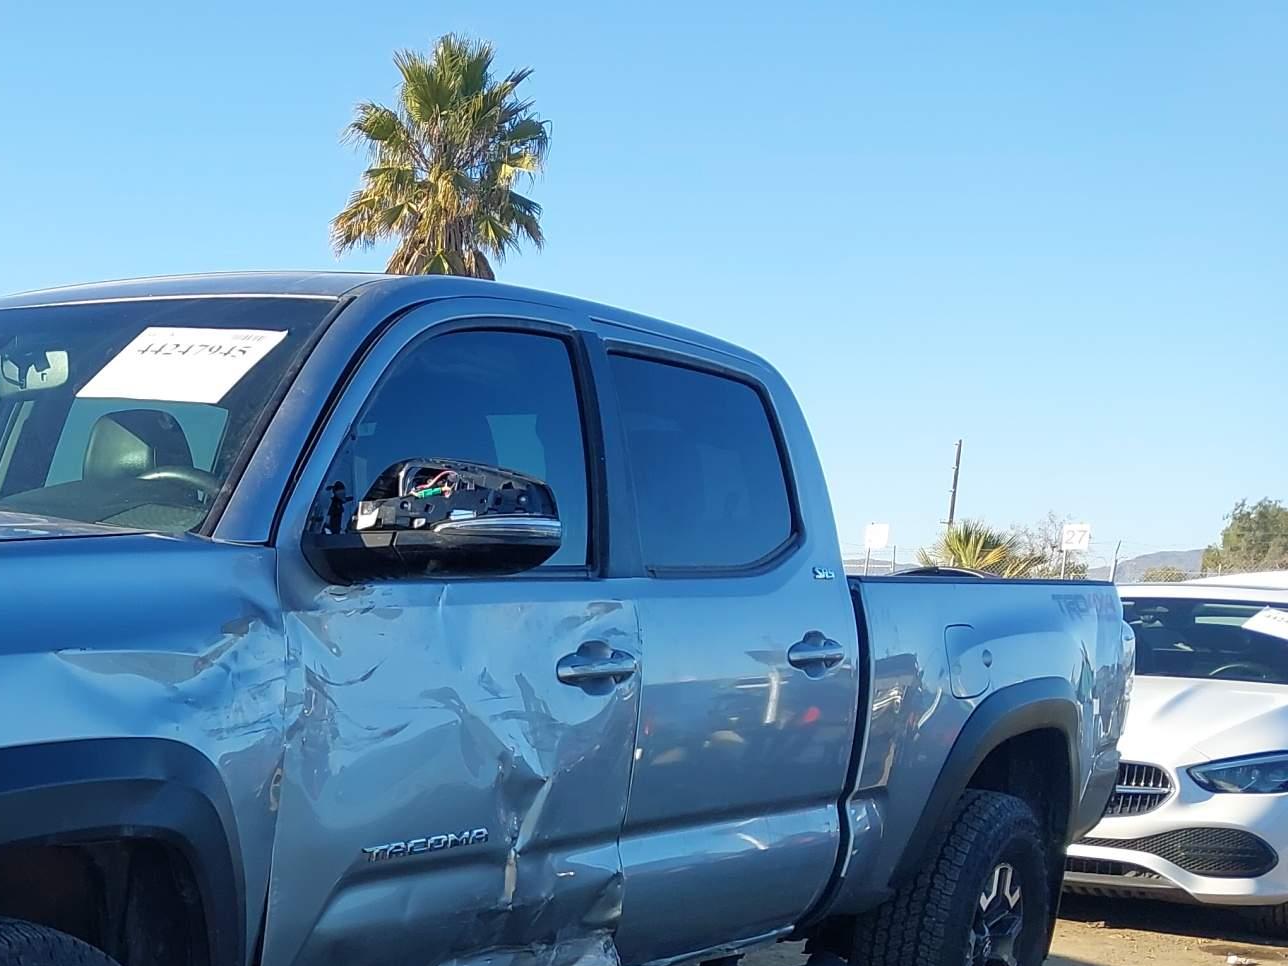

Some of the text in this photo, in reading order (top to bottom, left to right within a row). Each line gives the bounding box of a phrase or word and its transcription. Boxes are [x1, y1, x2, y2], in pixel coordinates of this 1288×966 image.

[137, 342, 253, 359] 44247945
[1064, 529, 1088, 545] 27
[361, 827, 489, 862] TACOMA
